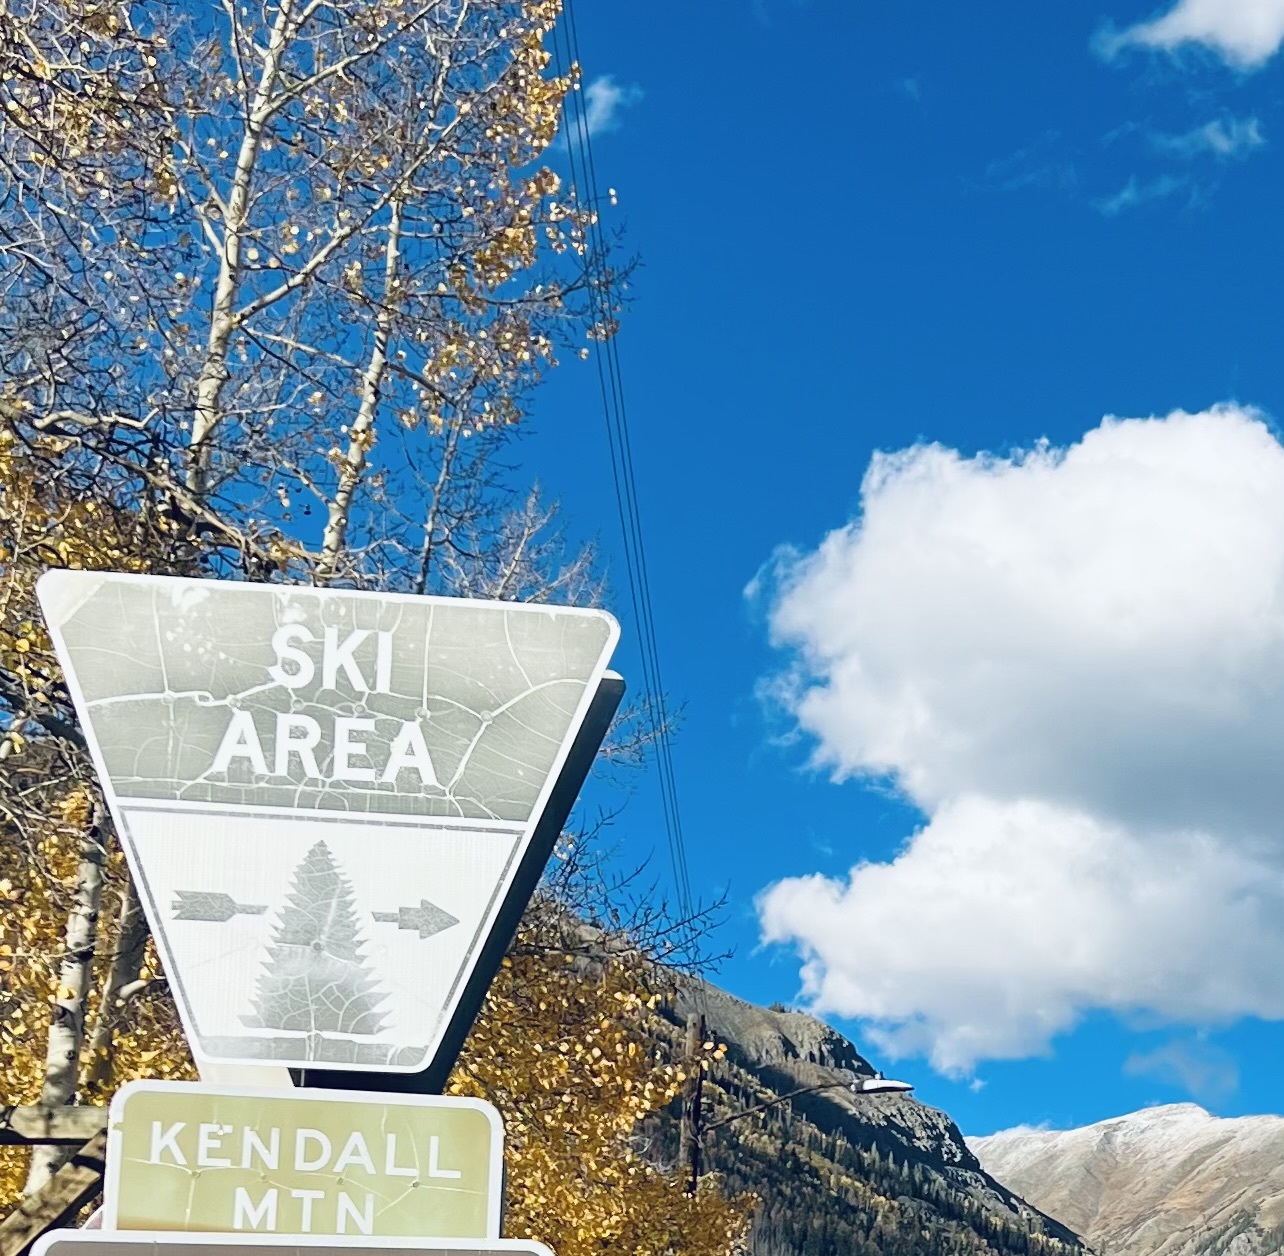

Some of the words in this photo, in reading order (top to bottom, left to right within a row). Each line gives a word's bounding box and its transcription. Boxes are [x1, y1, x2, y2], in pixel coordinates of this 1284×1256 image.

[267, 622, 394, 694] SKI
[209, 710, 438, 787] AREA
[148, 1120, 462, 1179] KENDALL
[232, 1186, 375, 1235] MTN
